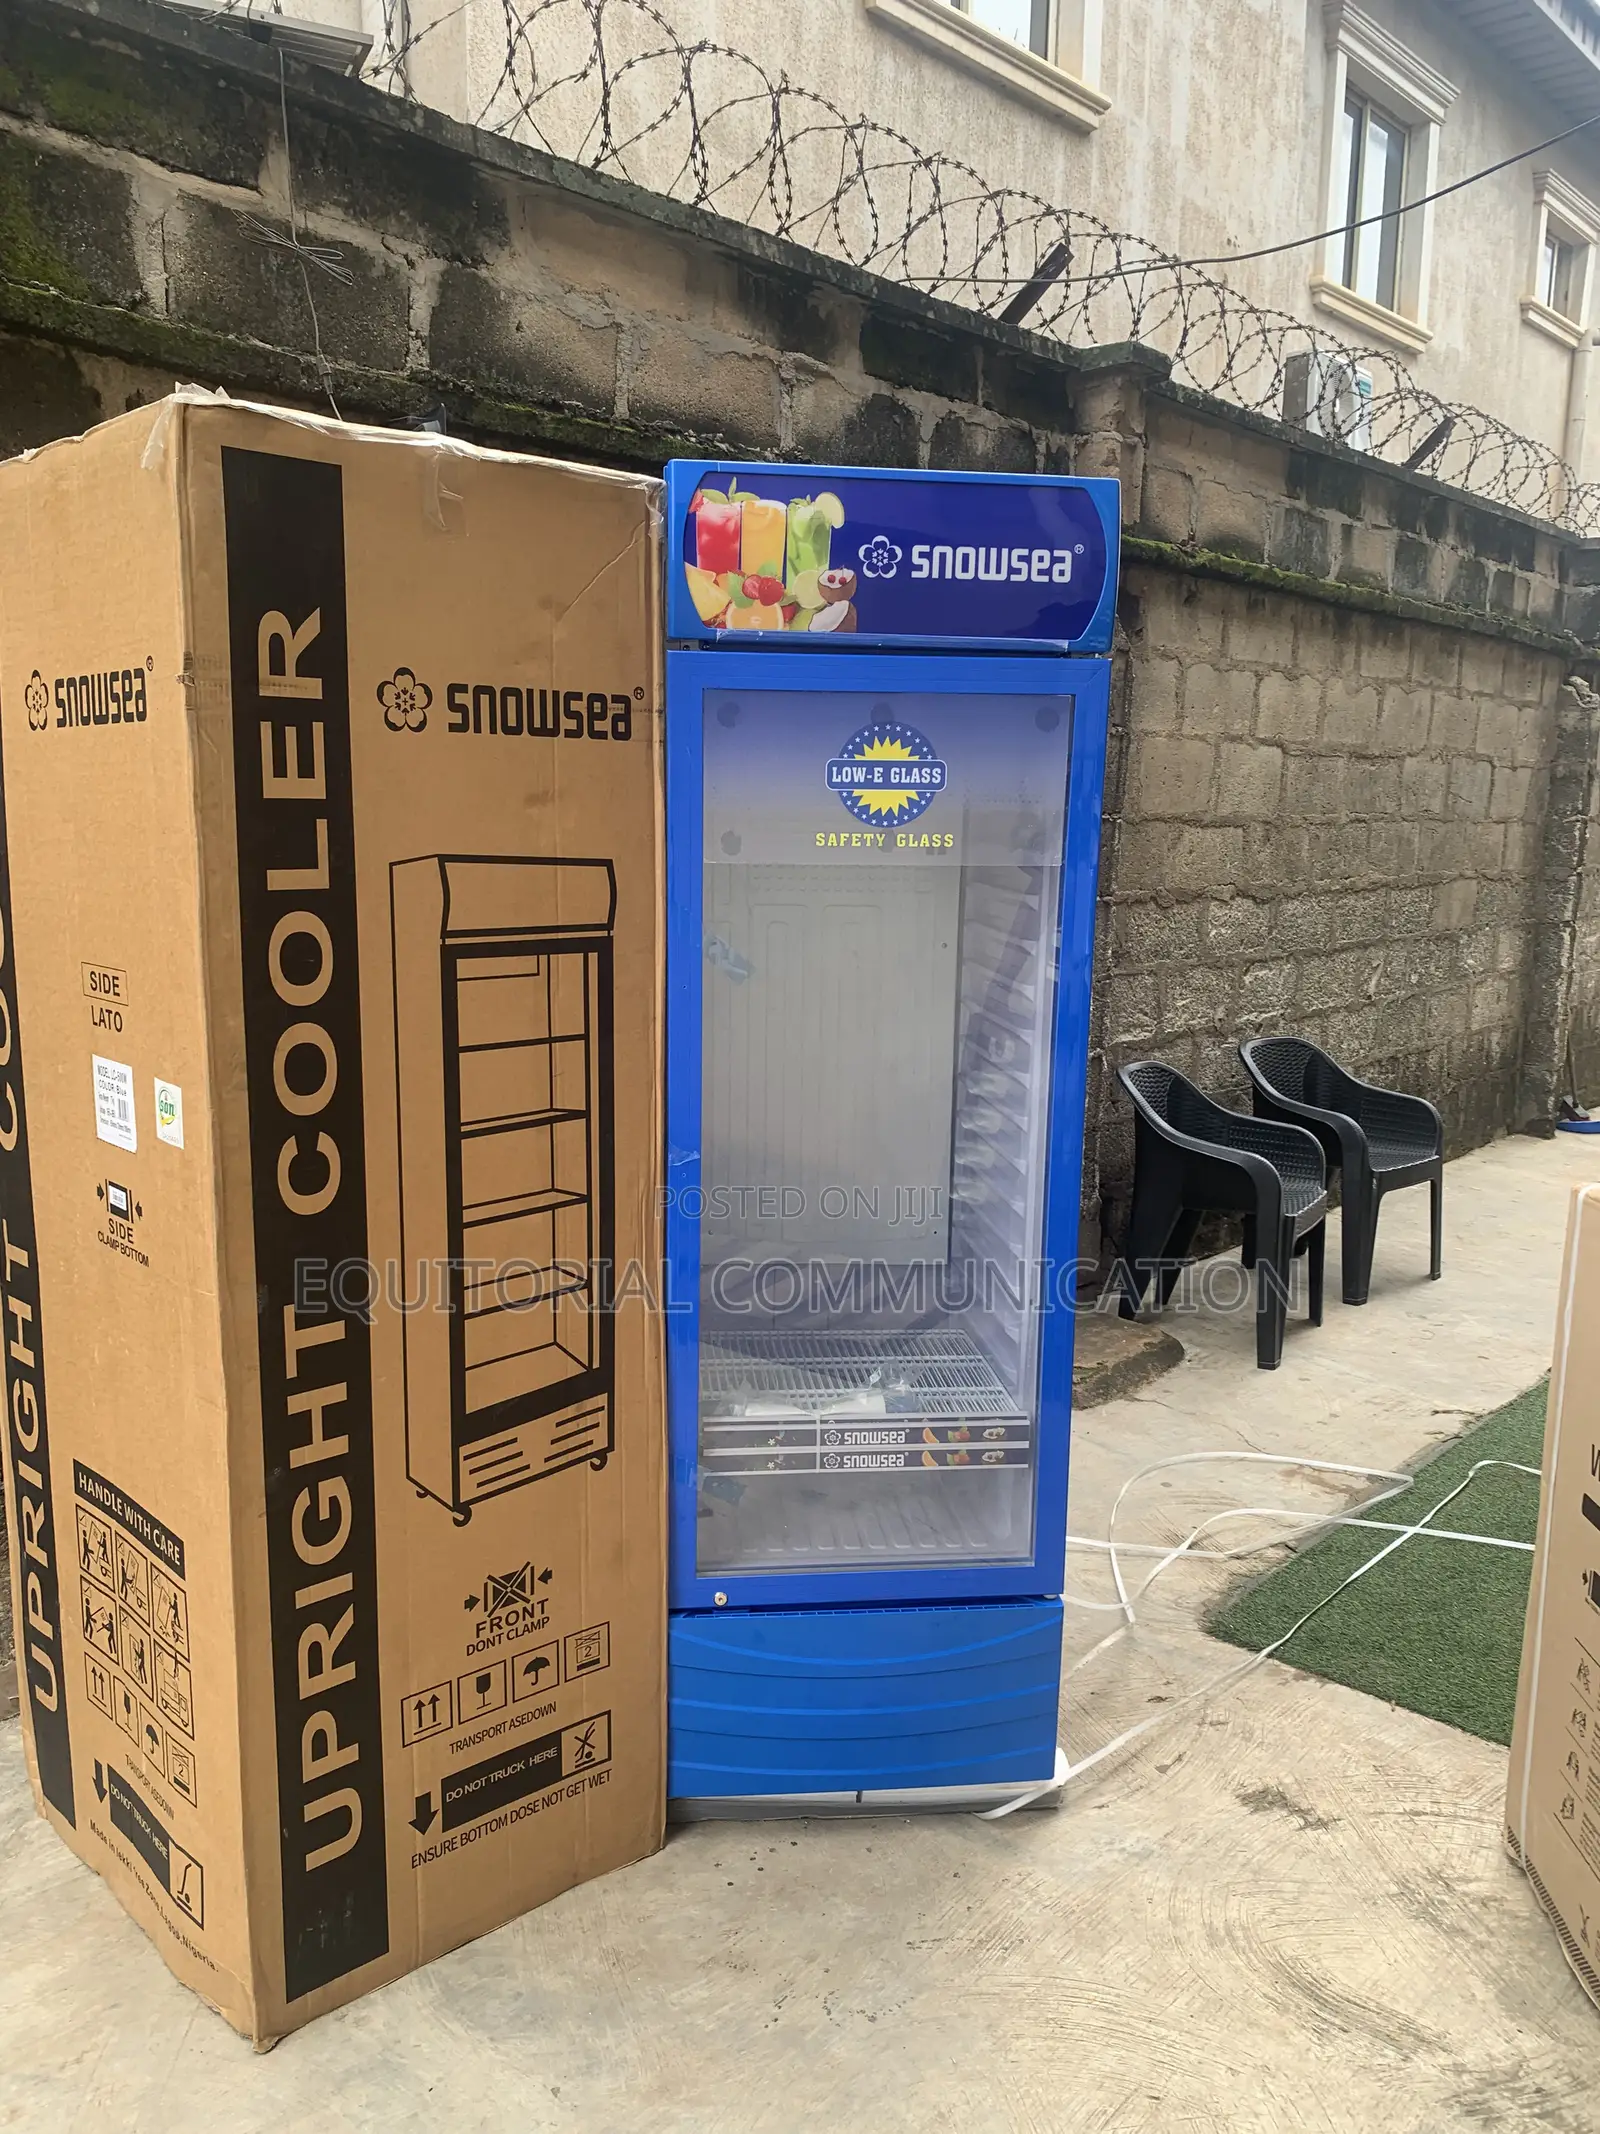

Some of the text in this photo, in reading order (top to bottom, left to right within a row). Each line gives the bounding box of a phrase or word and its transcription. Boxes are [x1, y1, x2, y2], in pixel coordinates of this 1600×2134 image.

[831, 765, 942, 785] LOW-E GLASS
[815, 831, 955, 849] SAFETY GLASS
[89, 970, 121, 998] SIDE
[91, 1004, 123, 1033] LATO
[97, 1230, 150, 1268] CLAMP BOTTOM
[108, 1217, 135, 1245] SIDE
[257, 606, 363, 1873] UPRIGHT COOLER
[2, 1218, 60, 1713] UPRIGHT
[78, 1471, 181, 1566] HANDLE WITH CARE
[466, 1616, 550, 1657] DONT CLAMP
[475, 1598, 549, 1638] FRONT
[449, 1701, 557, 1755] TRANSPORT ASEDOWN
[446, 1746, 559, 1803] DO NOT TRUCK HERE
[110, 1783, 121, 1800] DO
[152, 1831, 169, 1861] HERE
[410, 1768, 613, 1870] ENSURE BOTTOM DOSE NOT GET WET
